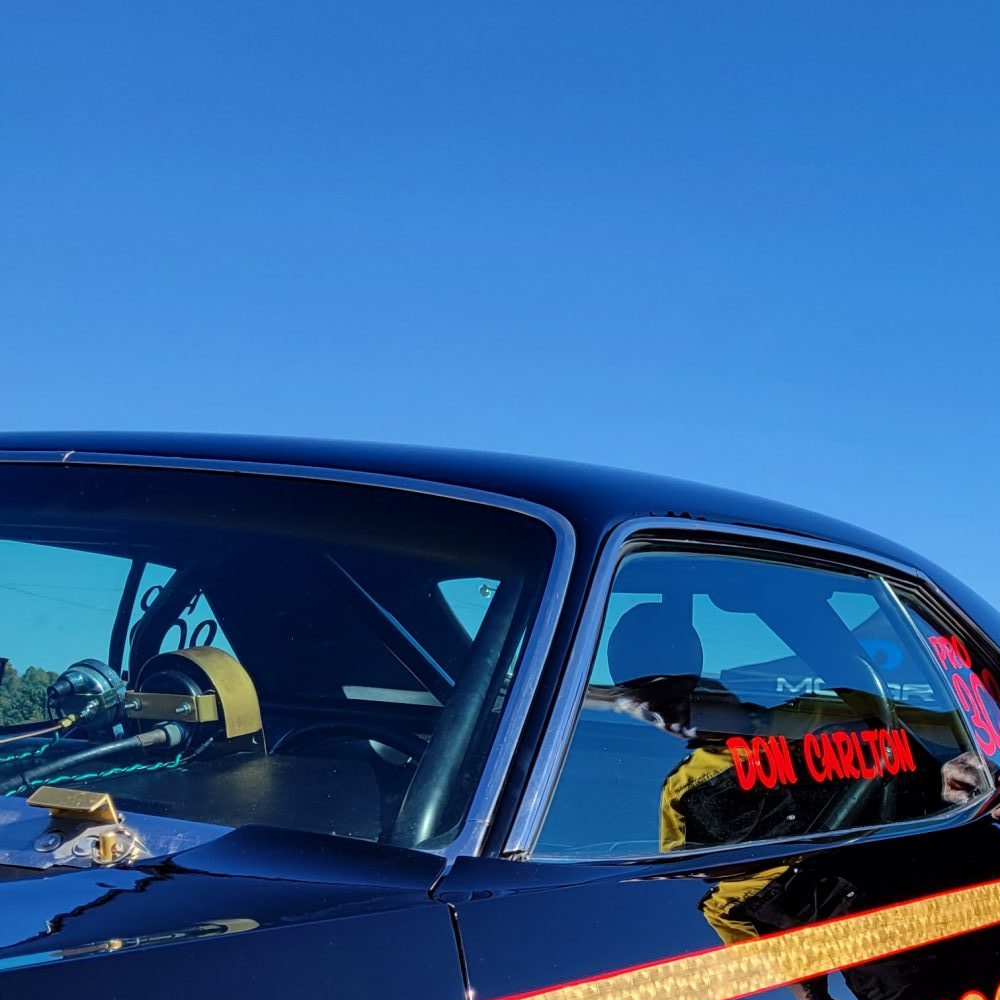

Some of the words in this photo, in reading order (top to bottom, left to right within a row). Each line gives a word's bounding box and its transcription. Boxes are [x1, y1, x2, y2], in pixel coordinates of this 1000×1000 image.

[928, 635, 972, 671] PRO
[726, 735, 798, 790] DON
[803, 727, 917, 783] CARLTON
